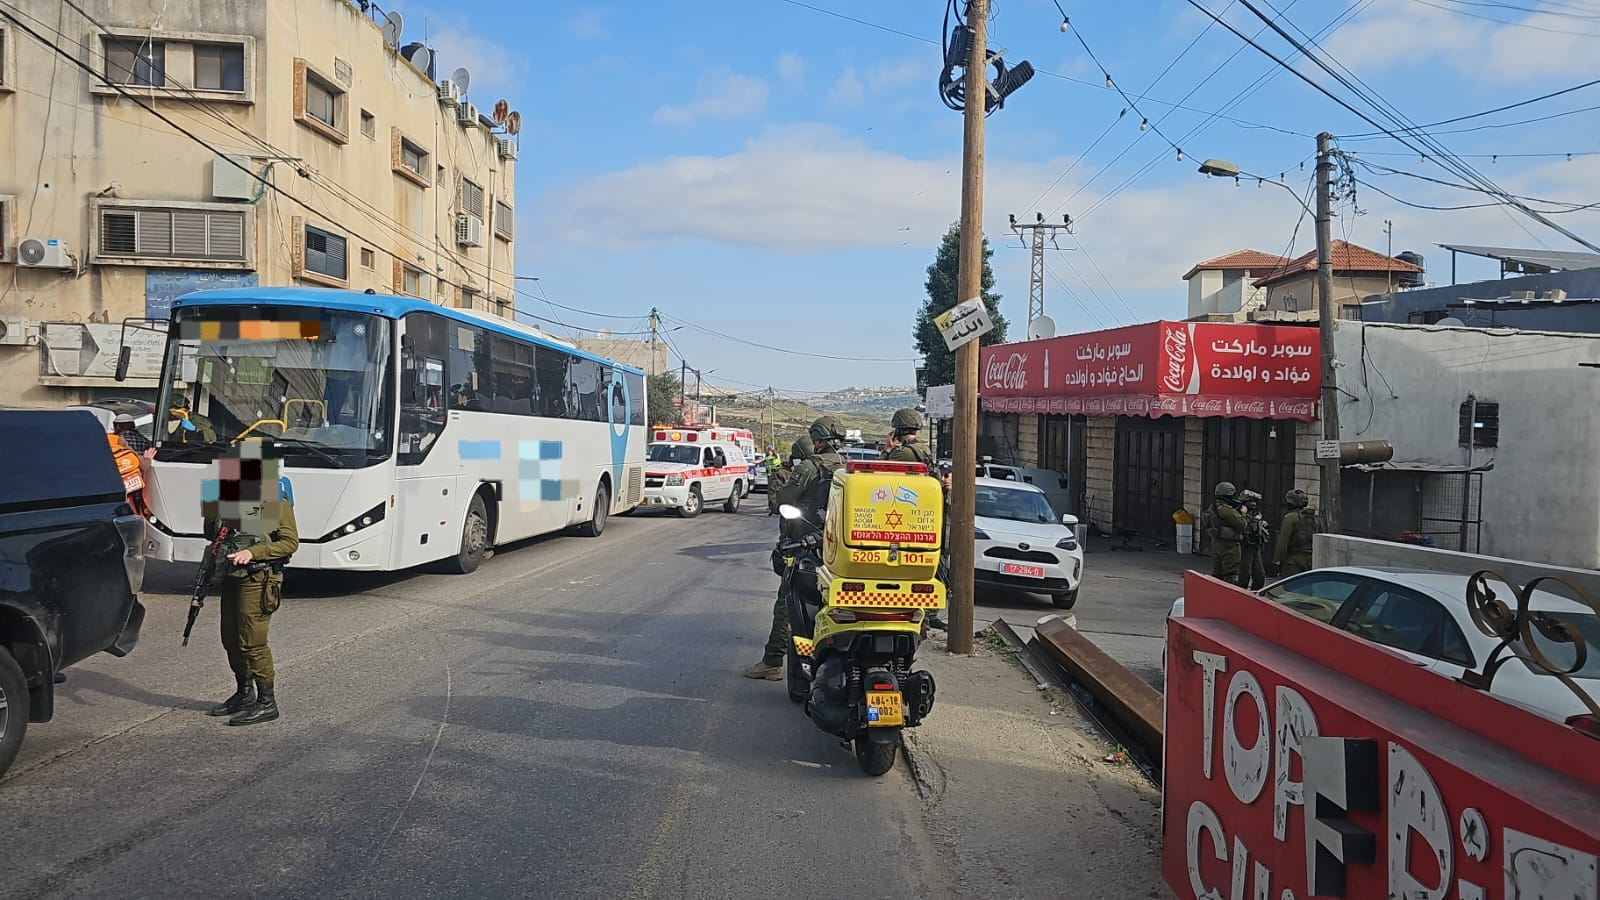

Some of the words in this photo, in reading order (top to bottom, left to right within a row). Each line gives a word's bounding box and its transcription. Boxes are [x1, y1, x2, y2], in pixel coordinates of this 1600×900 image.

[951, 318, 984, 341] الله
[1076, 344, 1105, 361] ماركت
[1107, 343, 1131, 361] سوبر
[1211, 339, 1267, 357] ماركت
[1271, 343, 1312, 358] سوبر
[1065, 366, 1088, 387] أولاده
[1090, 373, 1095, 387] و
[1097, 366, 1117, 387] فؤاد
[1119, 364, 1143, 386] الحاج
[1211, 363, 1257, 383] اولادة
[1261, 369, 1270, 383] و
[1274, 367, 1311, 384] فؤاد
[907, 523, 935, 531] בישראל
[884, 532, 911, 541] ההצלה
[914, 533, 935, 542] ארגון
[852, 552, 881, 562] 5205
[903, 553, 924, 563] 101
[879, 707, 894, 716] 002
